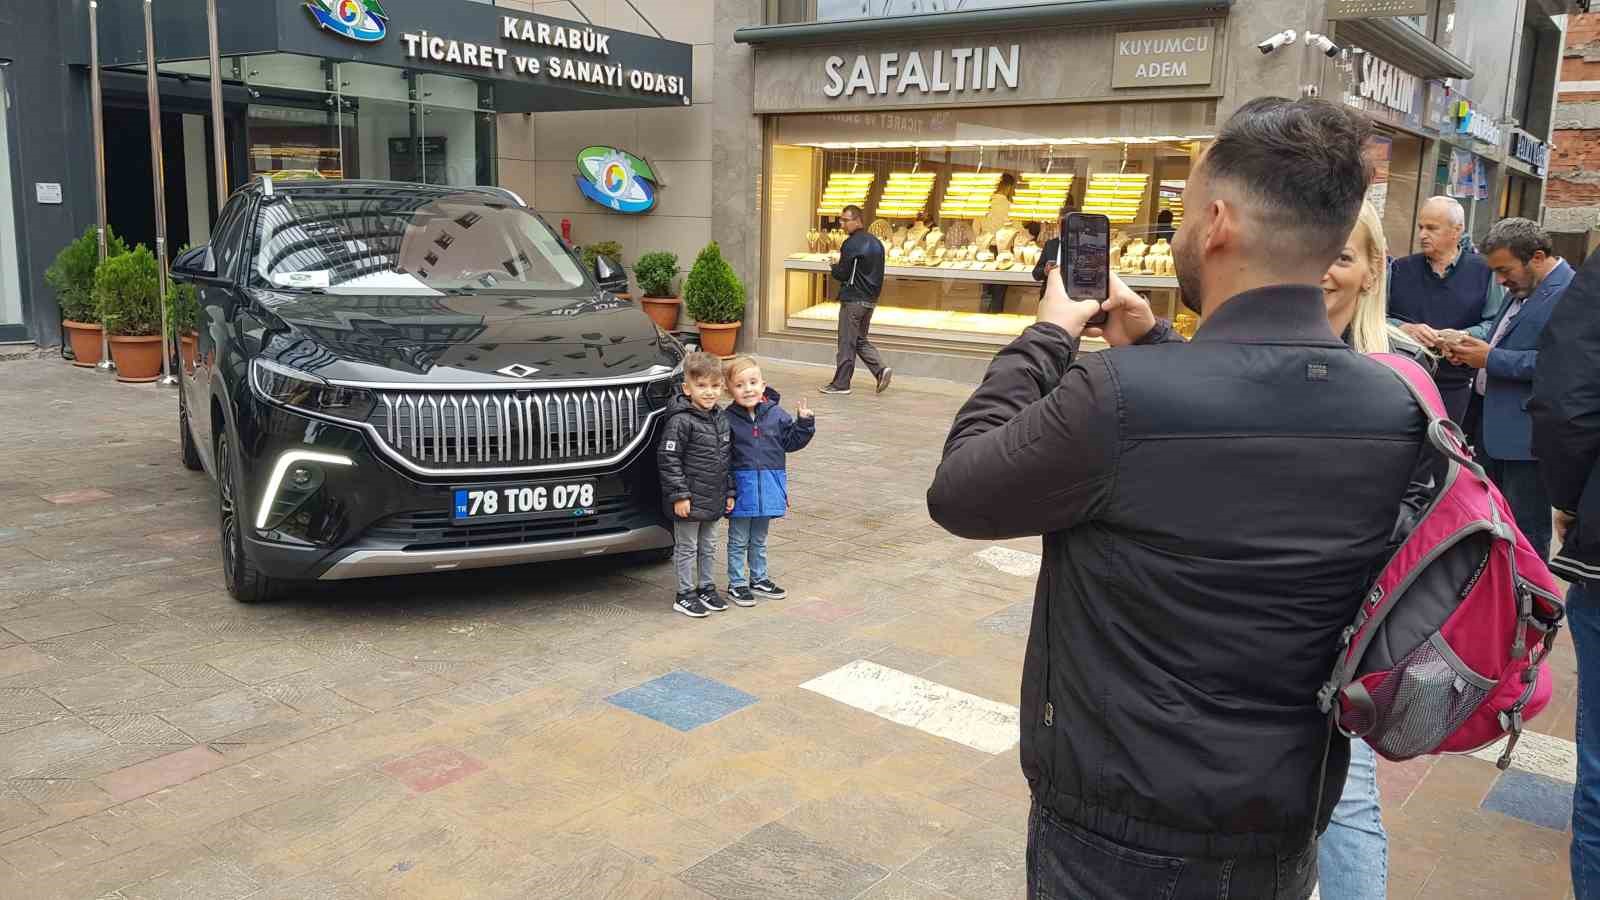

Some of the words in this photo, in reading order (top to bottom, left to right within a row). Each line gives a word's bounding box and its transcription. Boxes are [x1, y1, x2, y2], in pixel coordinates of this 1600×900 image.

[503, 16, 610, 55] KARABÜK
[1119, 35, 1208, 56] KUYUMCU
[403, 31, 507, 70] TİCARET
[516, 56, 539, 74] ve
[549, 57, 623, 87] SANAYİ
[630, 70, 684, 96] ODASI
[823, 44, 1020, 97] SAFALTIN
[1135, 61, 1187, 79] ADEM
[1360, 52, 1415, 114] SAFALTIN
[468, 490, 498, 515] 78
[504, 487, 547, 512] TOG
[553, 484, 594, 509] 078
